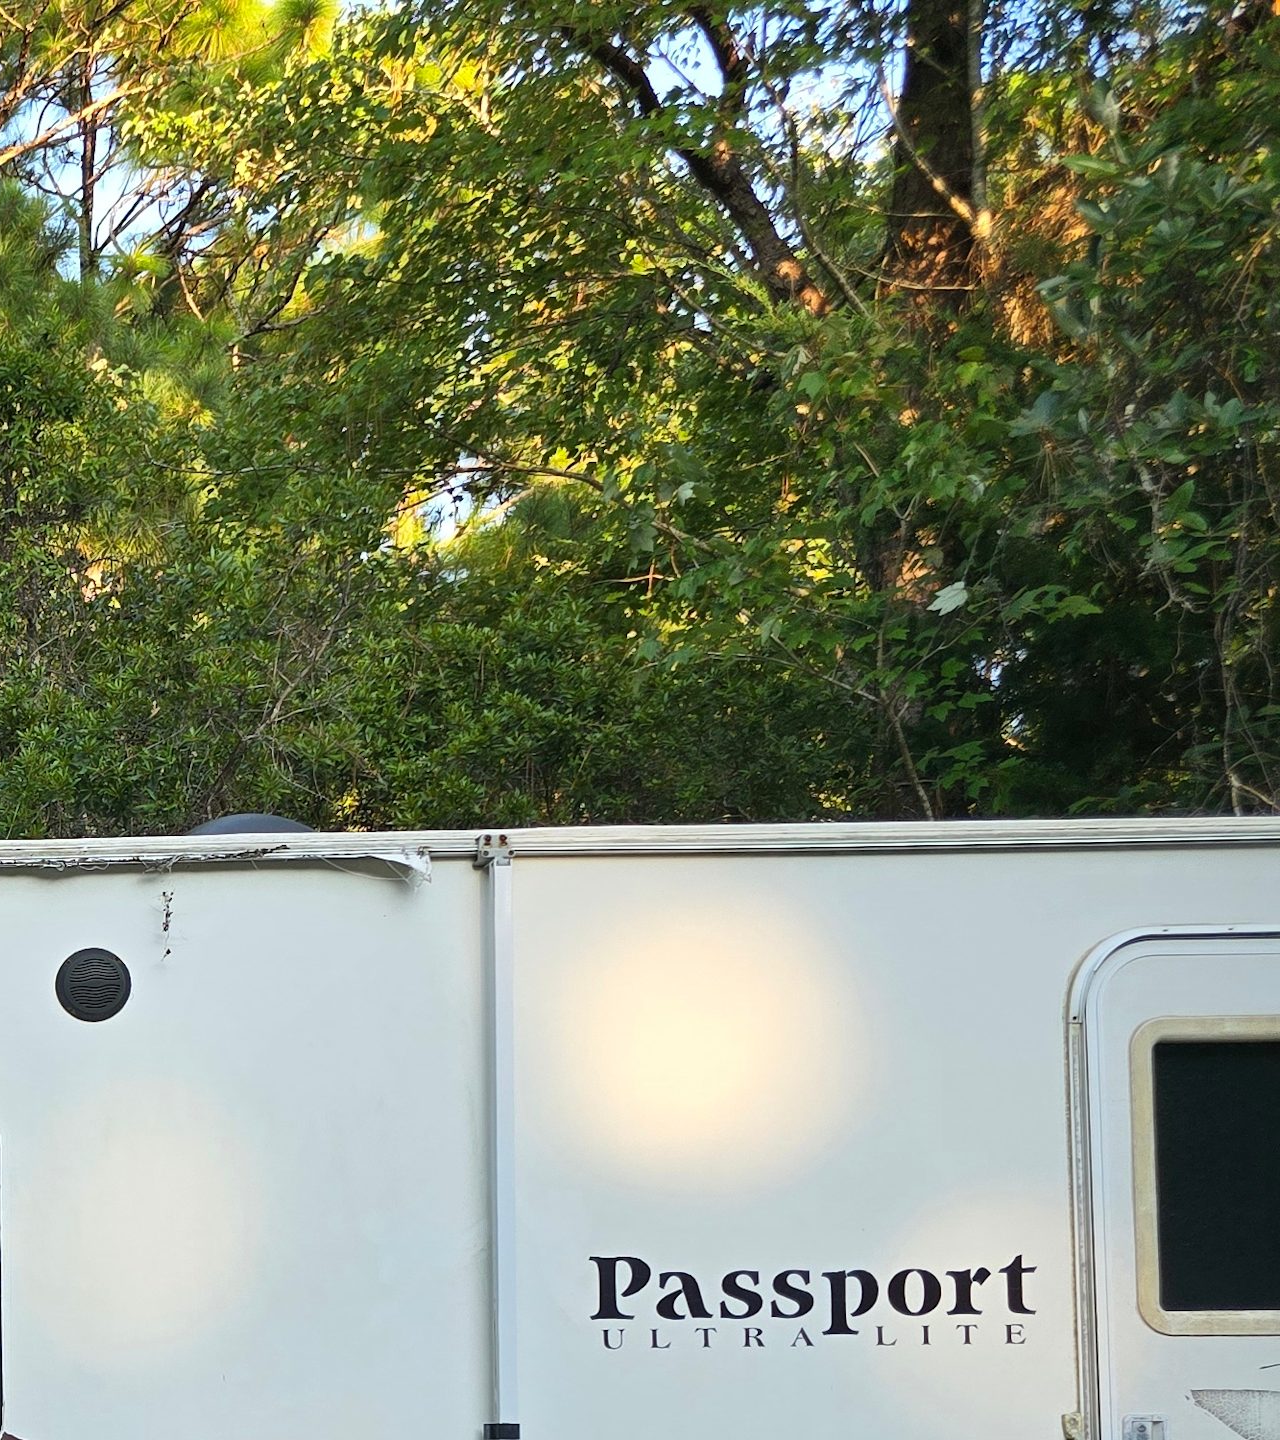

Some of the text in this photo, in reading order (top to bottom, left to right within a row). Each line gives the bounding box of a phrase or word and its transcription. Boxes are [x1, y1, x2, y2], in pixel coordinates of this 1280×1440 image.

[588, 1254, 1037, 1336] Passport
[602, 1323, 1027, 1350] ULTRA LITE
